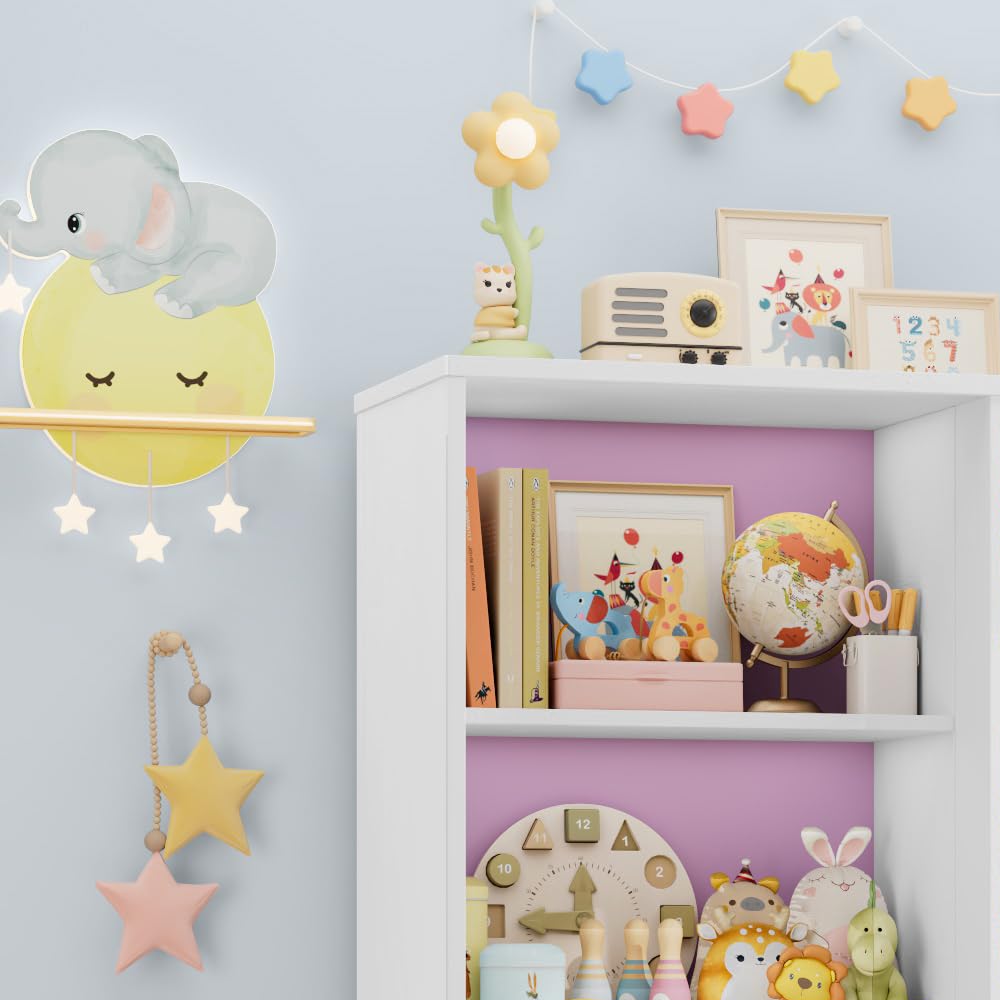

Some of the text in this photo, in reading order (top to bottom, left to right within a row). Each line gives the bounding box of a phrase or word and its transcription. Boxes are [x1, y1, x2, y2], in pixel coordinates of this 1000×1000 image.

[908, 315, 923, 335] 2
[928, 316, 941, 336] 3
[946, 317, 960, 337] 4
[899, 340, 917, 362] 5
[941, 339, 958, 362] 7
[575, 818, 591, 831] 12
[533, 832, 548, 844] 11
[622, 836, 630, 847] 1
[497, 862, 512, 874] 10
[655, 866, 665, 878] 2
